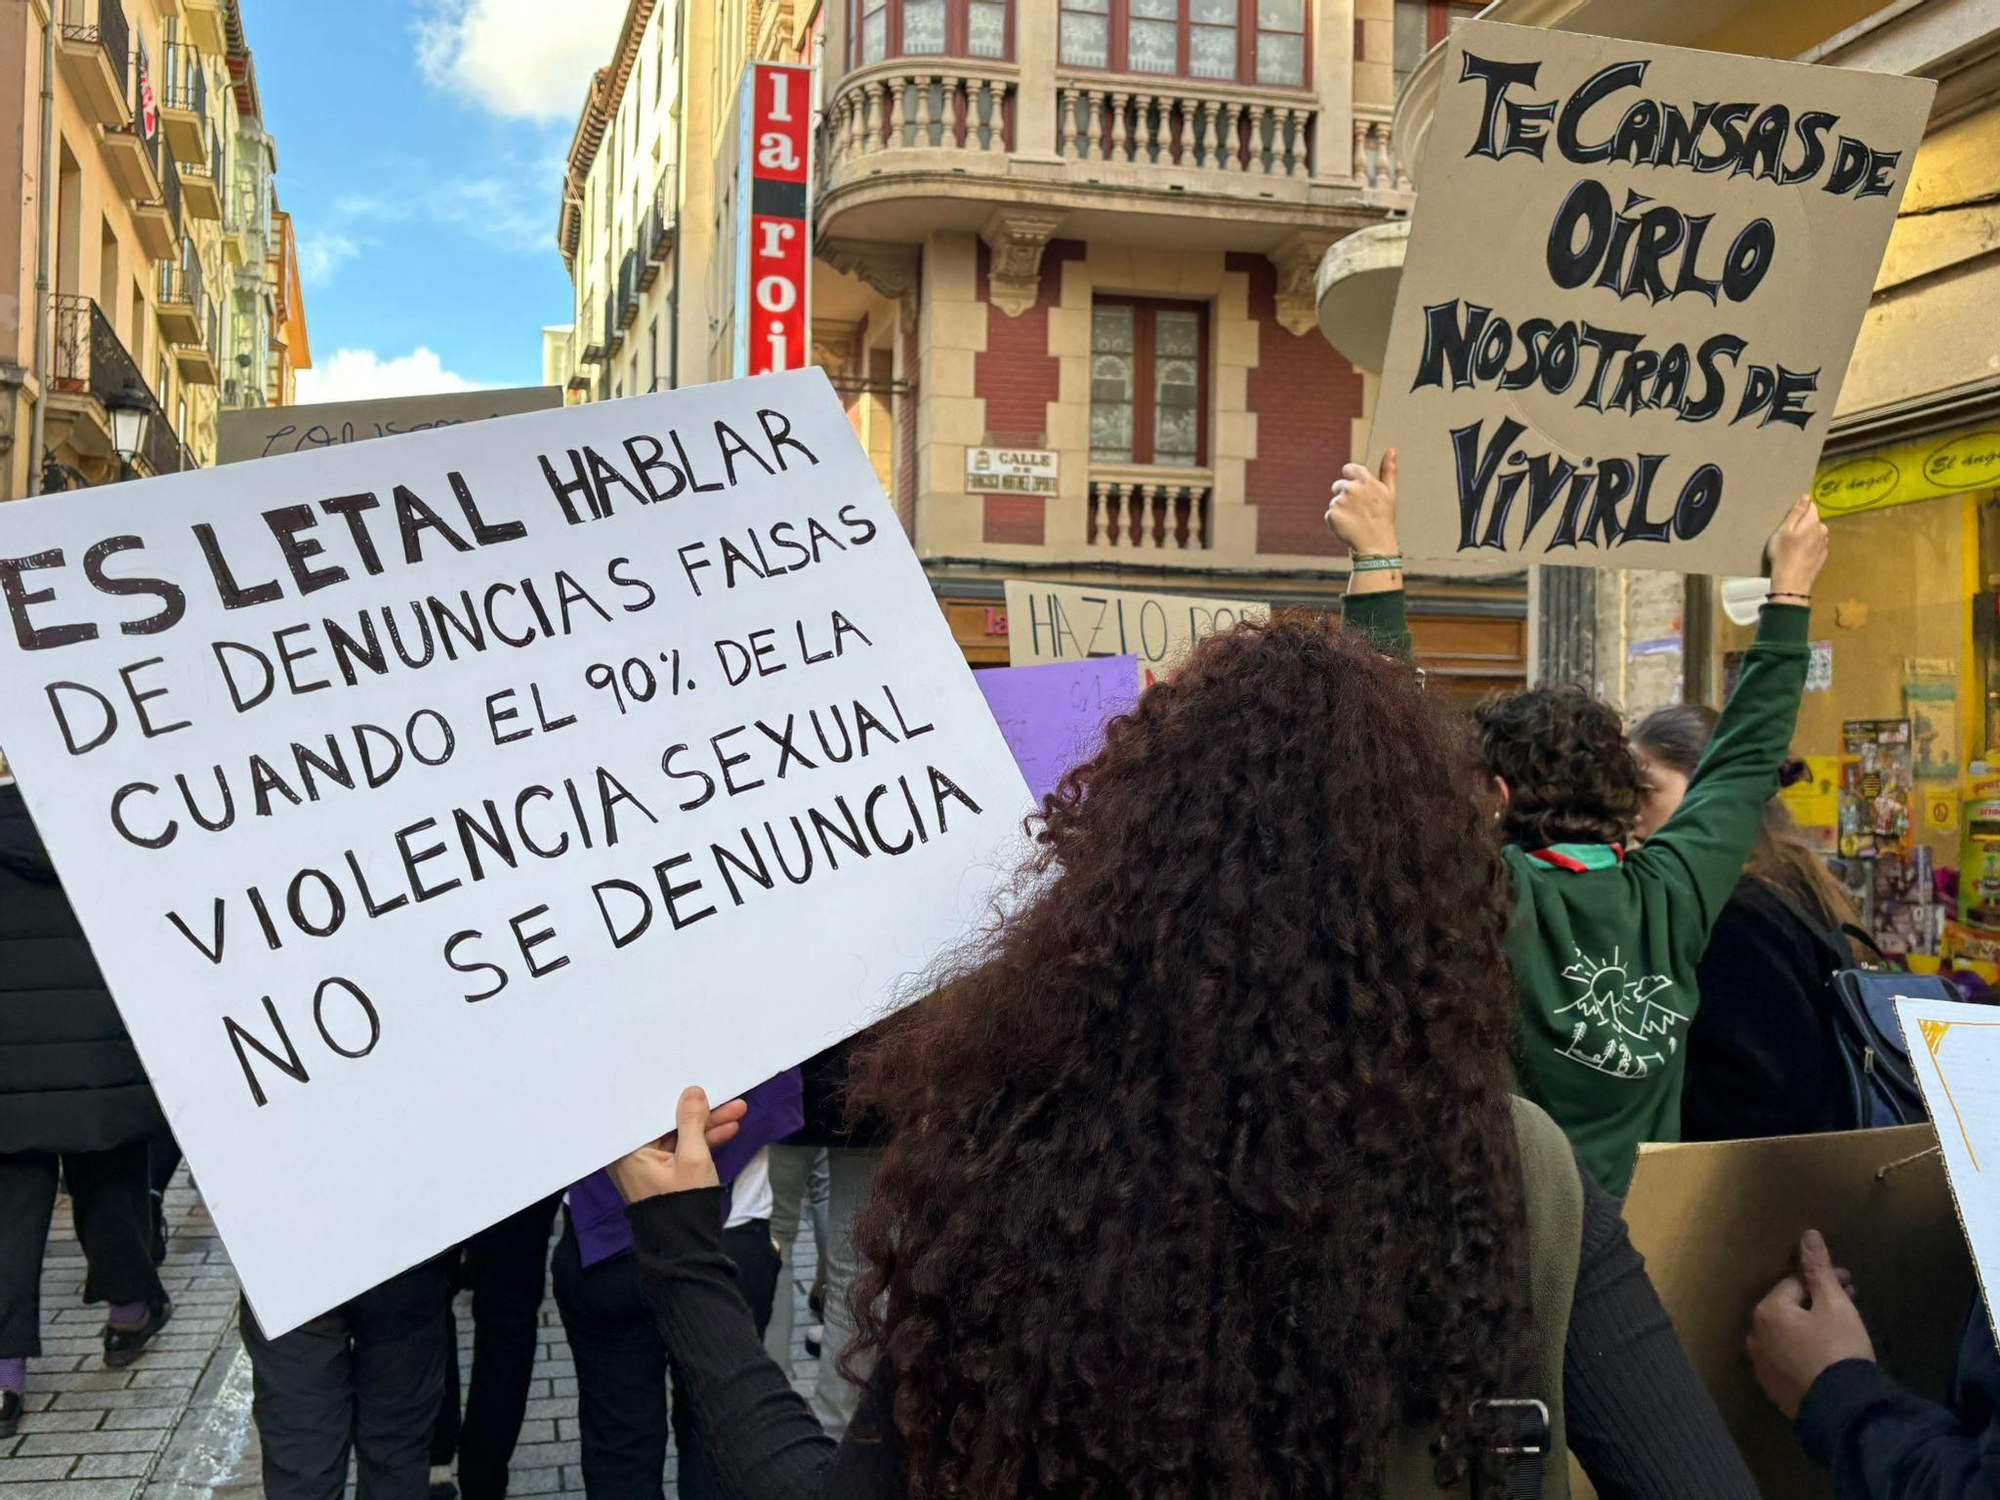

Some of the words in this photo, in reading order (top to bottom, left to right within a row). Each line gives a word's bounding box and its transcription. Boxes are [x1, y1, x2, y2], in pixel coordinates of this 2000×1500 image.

[1459, 50, 1559, 163] TE
[1557, 60, 1841, 186] CANSAS
[1822, 136, 1903, 201] DE
[998, 452, 1050, 466] CALLE
[1410, 299, 1749, 423] NOSOTRAS
[1729, 364, 1822, 431] DE
[0, 535, 187, 651] ES
[192, 472, 528, 610] LETAL
[538, 410, 821, 526] HABLAR
[45, 657, 193, 756] DE
[212, 557, 656, 714] DENUNCIAS
[678, 504, 878, 598] FALSAS
[111, 709, 456, 850] CUANDO
[486, 683, 578, 746] EL
[585, 648, 697, 715] 90%
[715, 629, 788, 687] DE
[797, 611, 874, 666] LA
[166, 767, 660, 966] VIOLENCIA
[662, 685, 936, 813] SEXUAL
[222, 977, 381, 1107] NO
[445, 904, 571, 1004] SE
[592, 765, 984, 949] DENUNCIA
